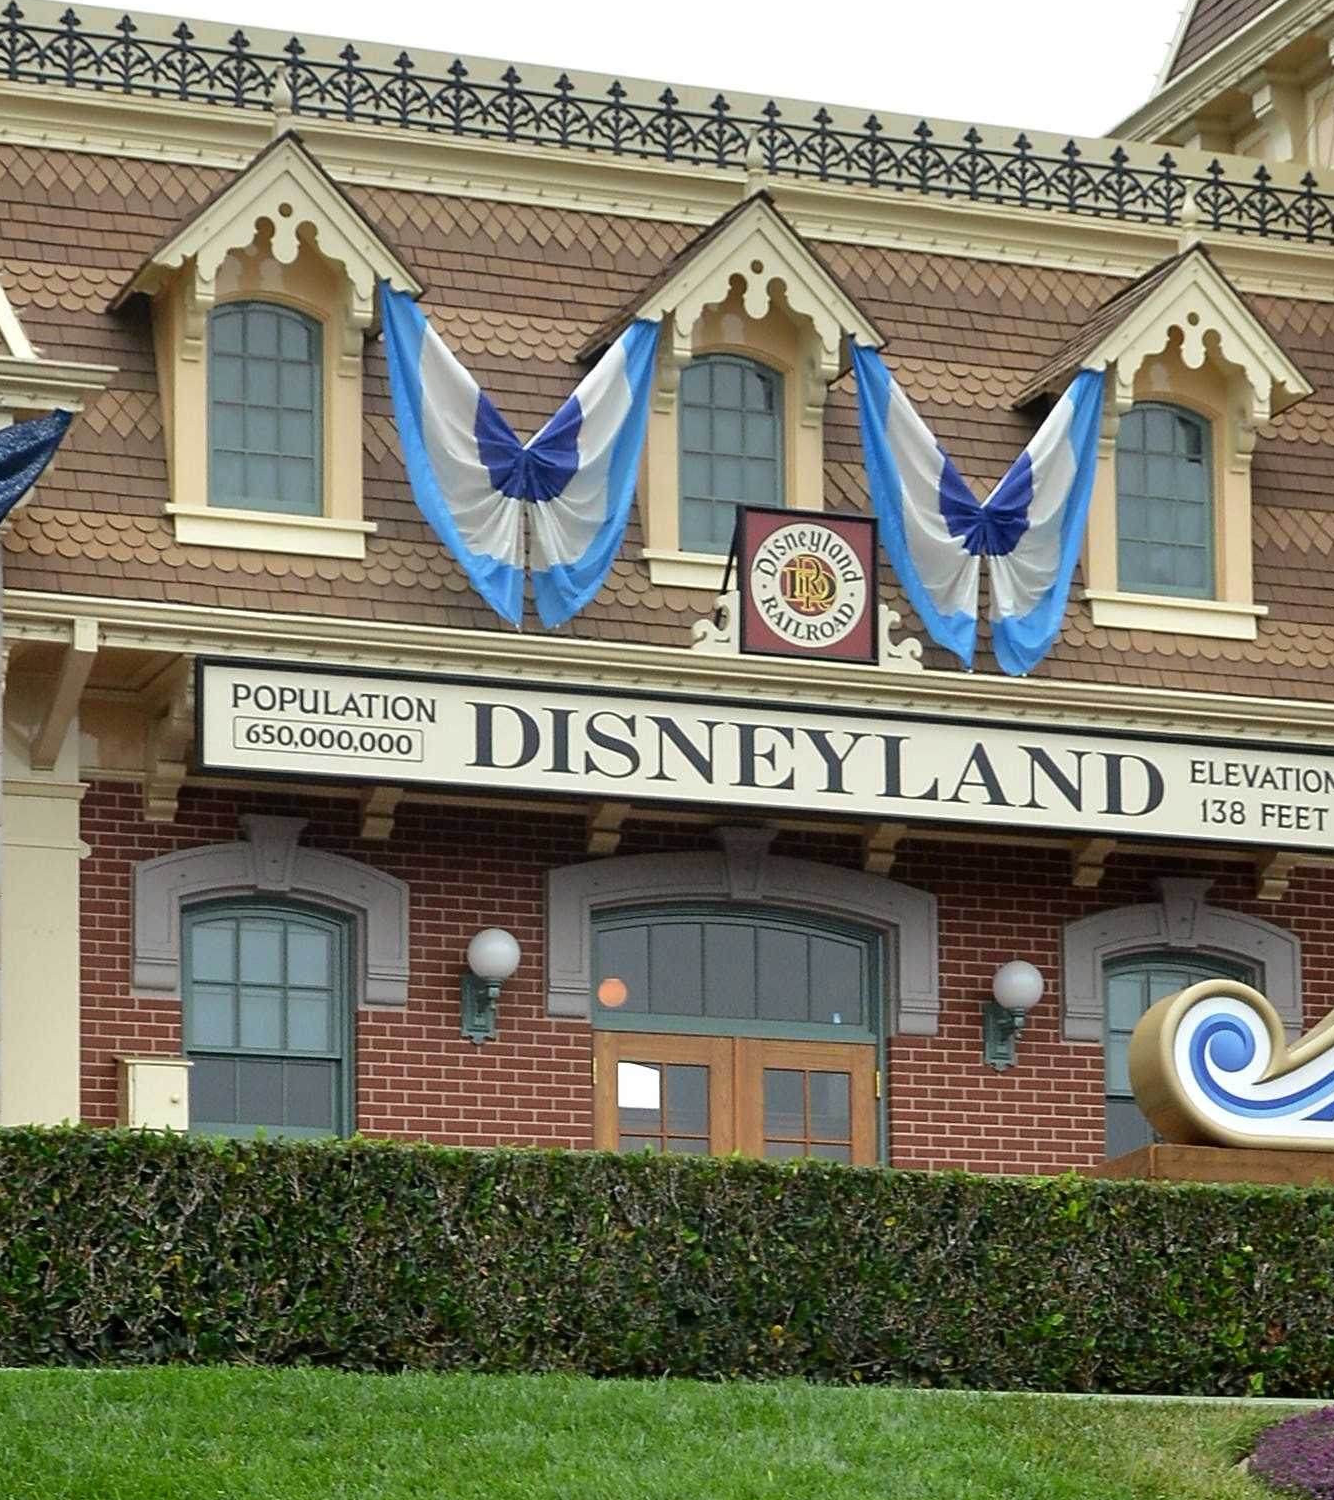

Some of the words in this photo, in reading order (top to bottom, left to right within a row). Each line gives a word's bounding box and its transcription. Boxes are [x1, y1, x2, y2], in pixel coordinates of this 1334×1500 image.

[754, 530, 864, 583] Disneyland
[761, 595, 855, 641] RAILROAD
[231, 683, 437, 723] POPULATION
[245, 723, 413, 755] 650,000,000
[465, 701, 1165, 817] DISNEYLAND
[1201, 799, 1246, 825] 138
[1261, 803, 1329, 831] FEET
